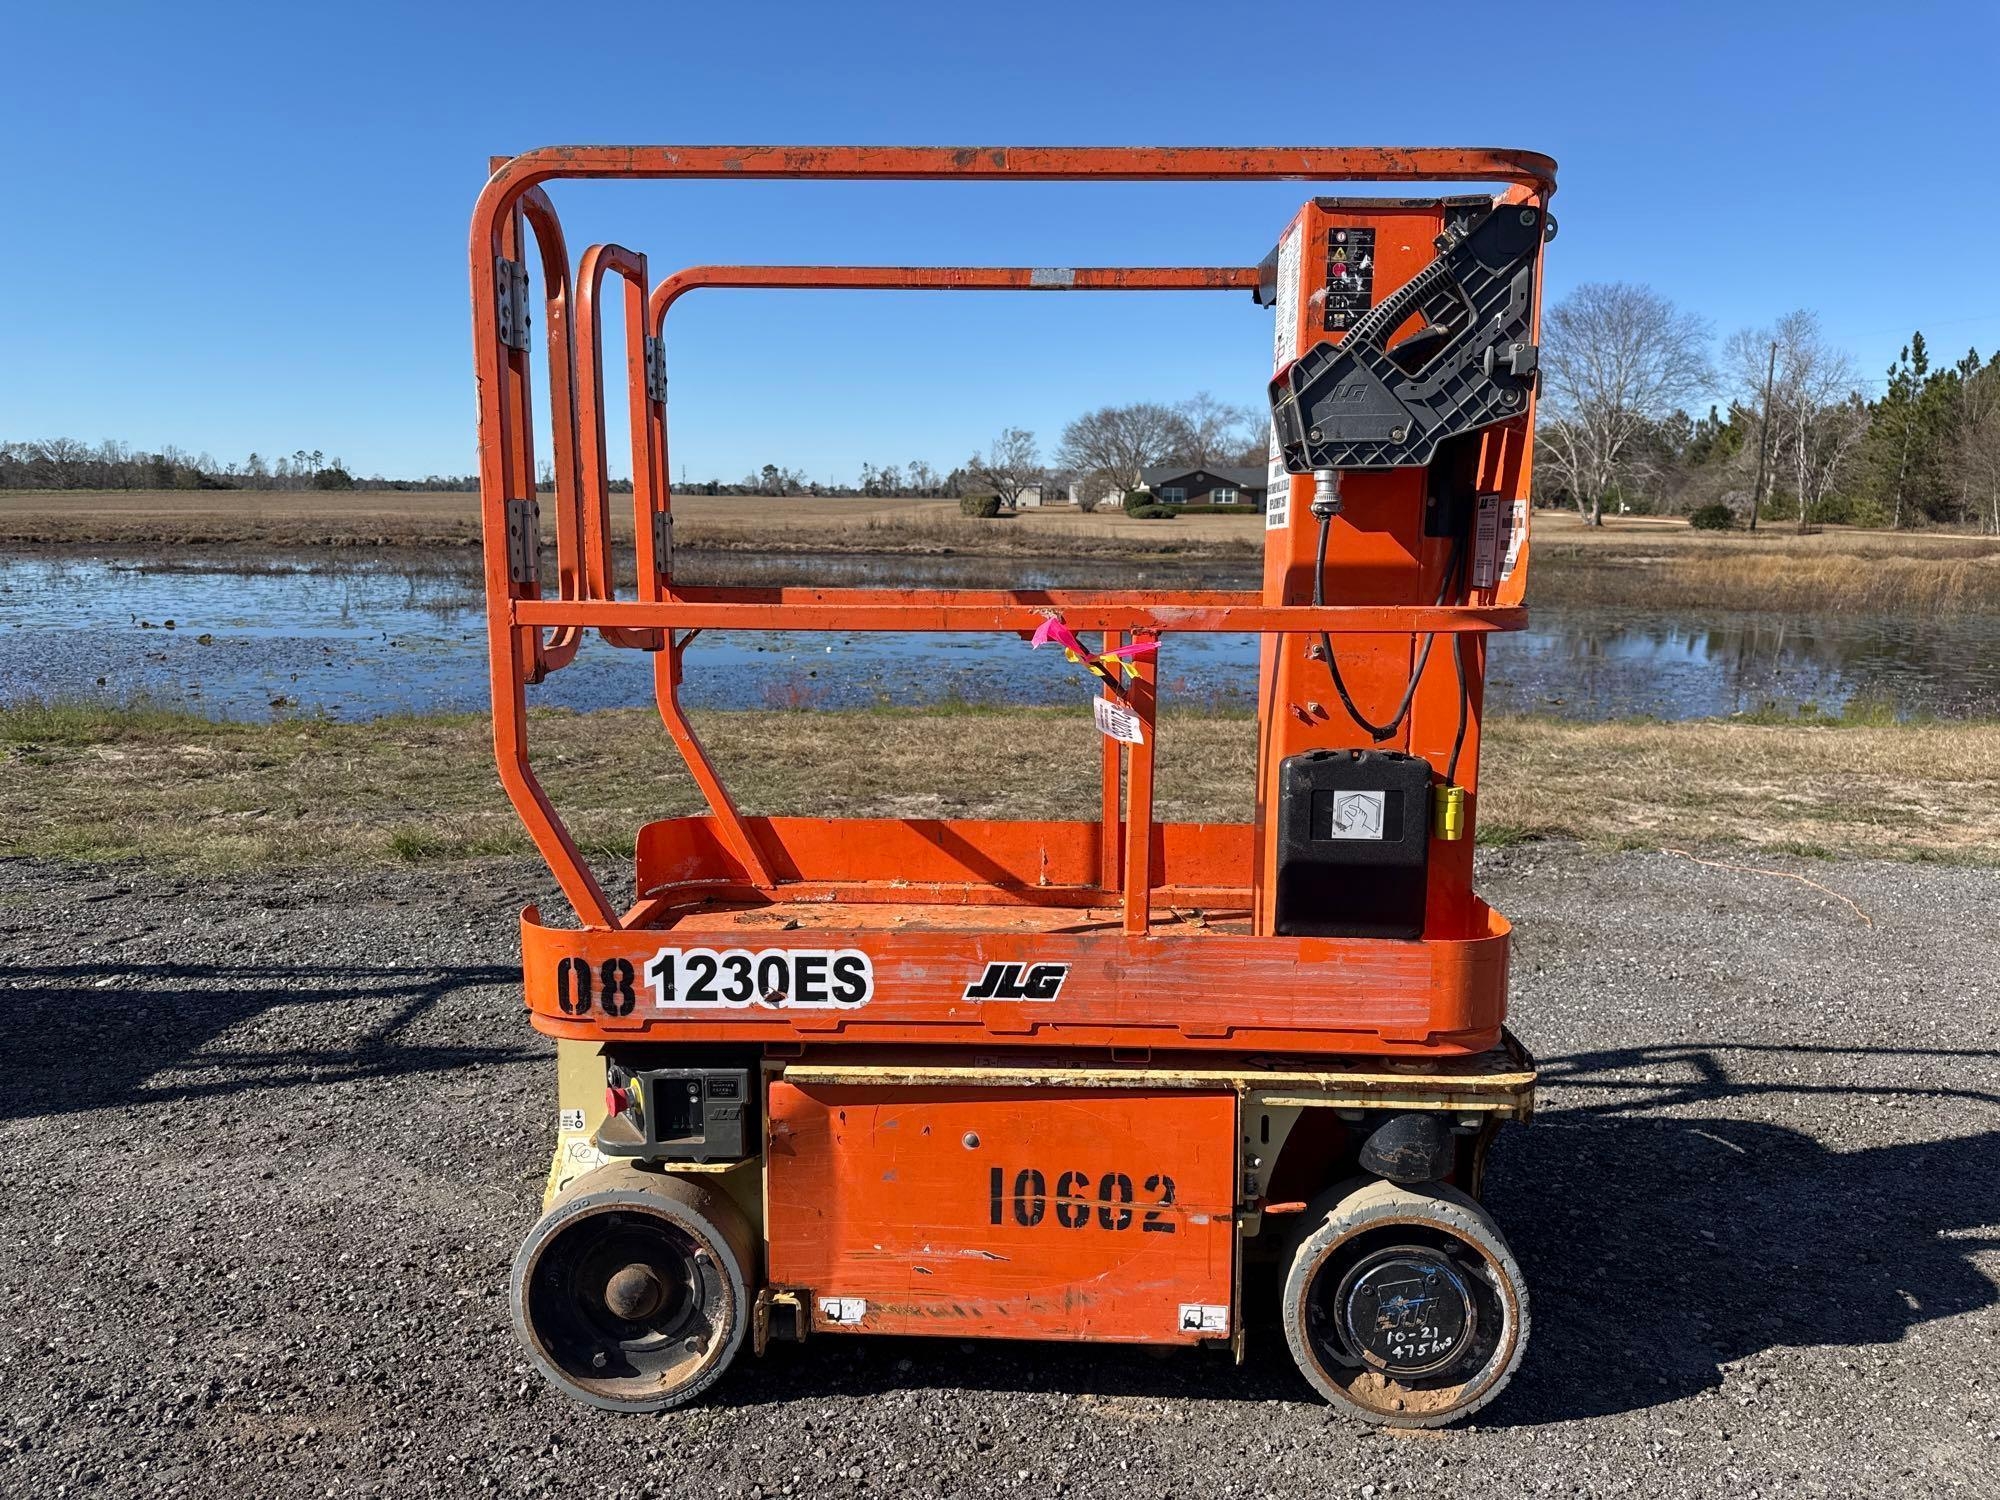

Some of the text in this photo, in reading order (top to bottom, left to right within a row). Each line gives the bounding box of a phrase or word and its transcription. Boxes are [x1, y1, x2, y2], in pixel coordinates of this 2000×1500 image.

[557, 957, 636, 1017] 08
[651, 954, 867, 1003] 1230ES
[965, 963, 1067, 999] JLG
[990, 1167, 1176, 1233] 10602
[1387, 1326, 1439, 1345] 10-21
